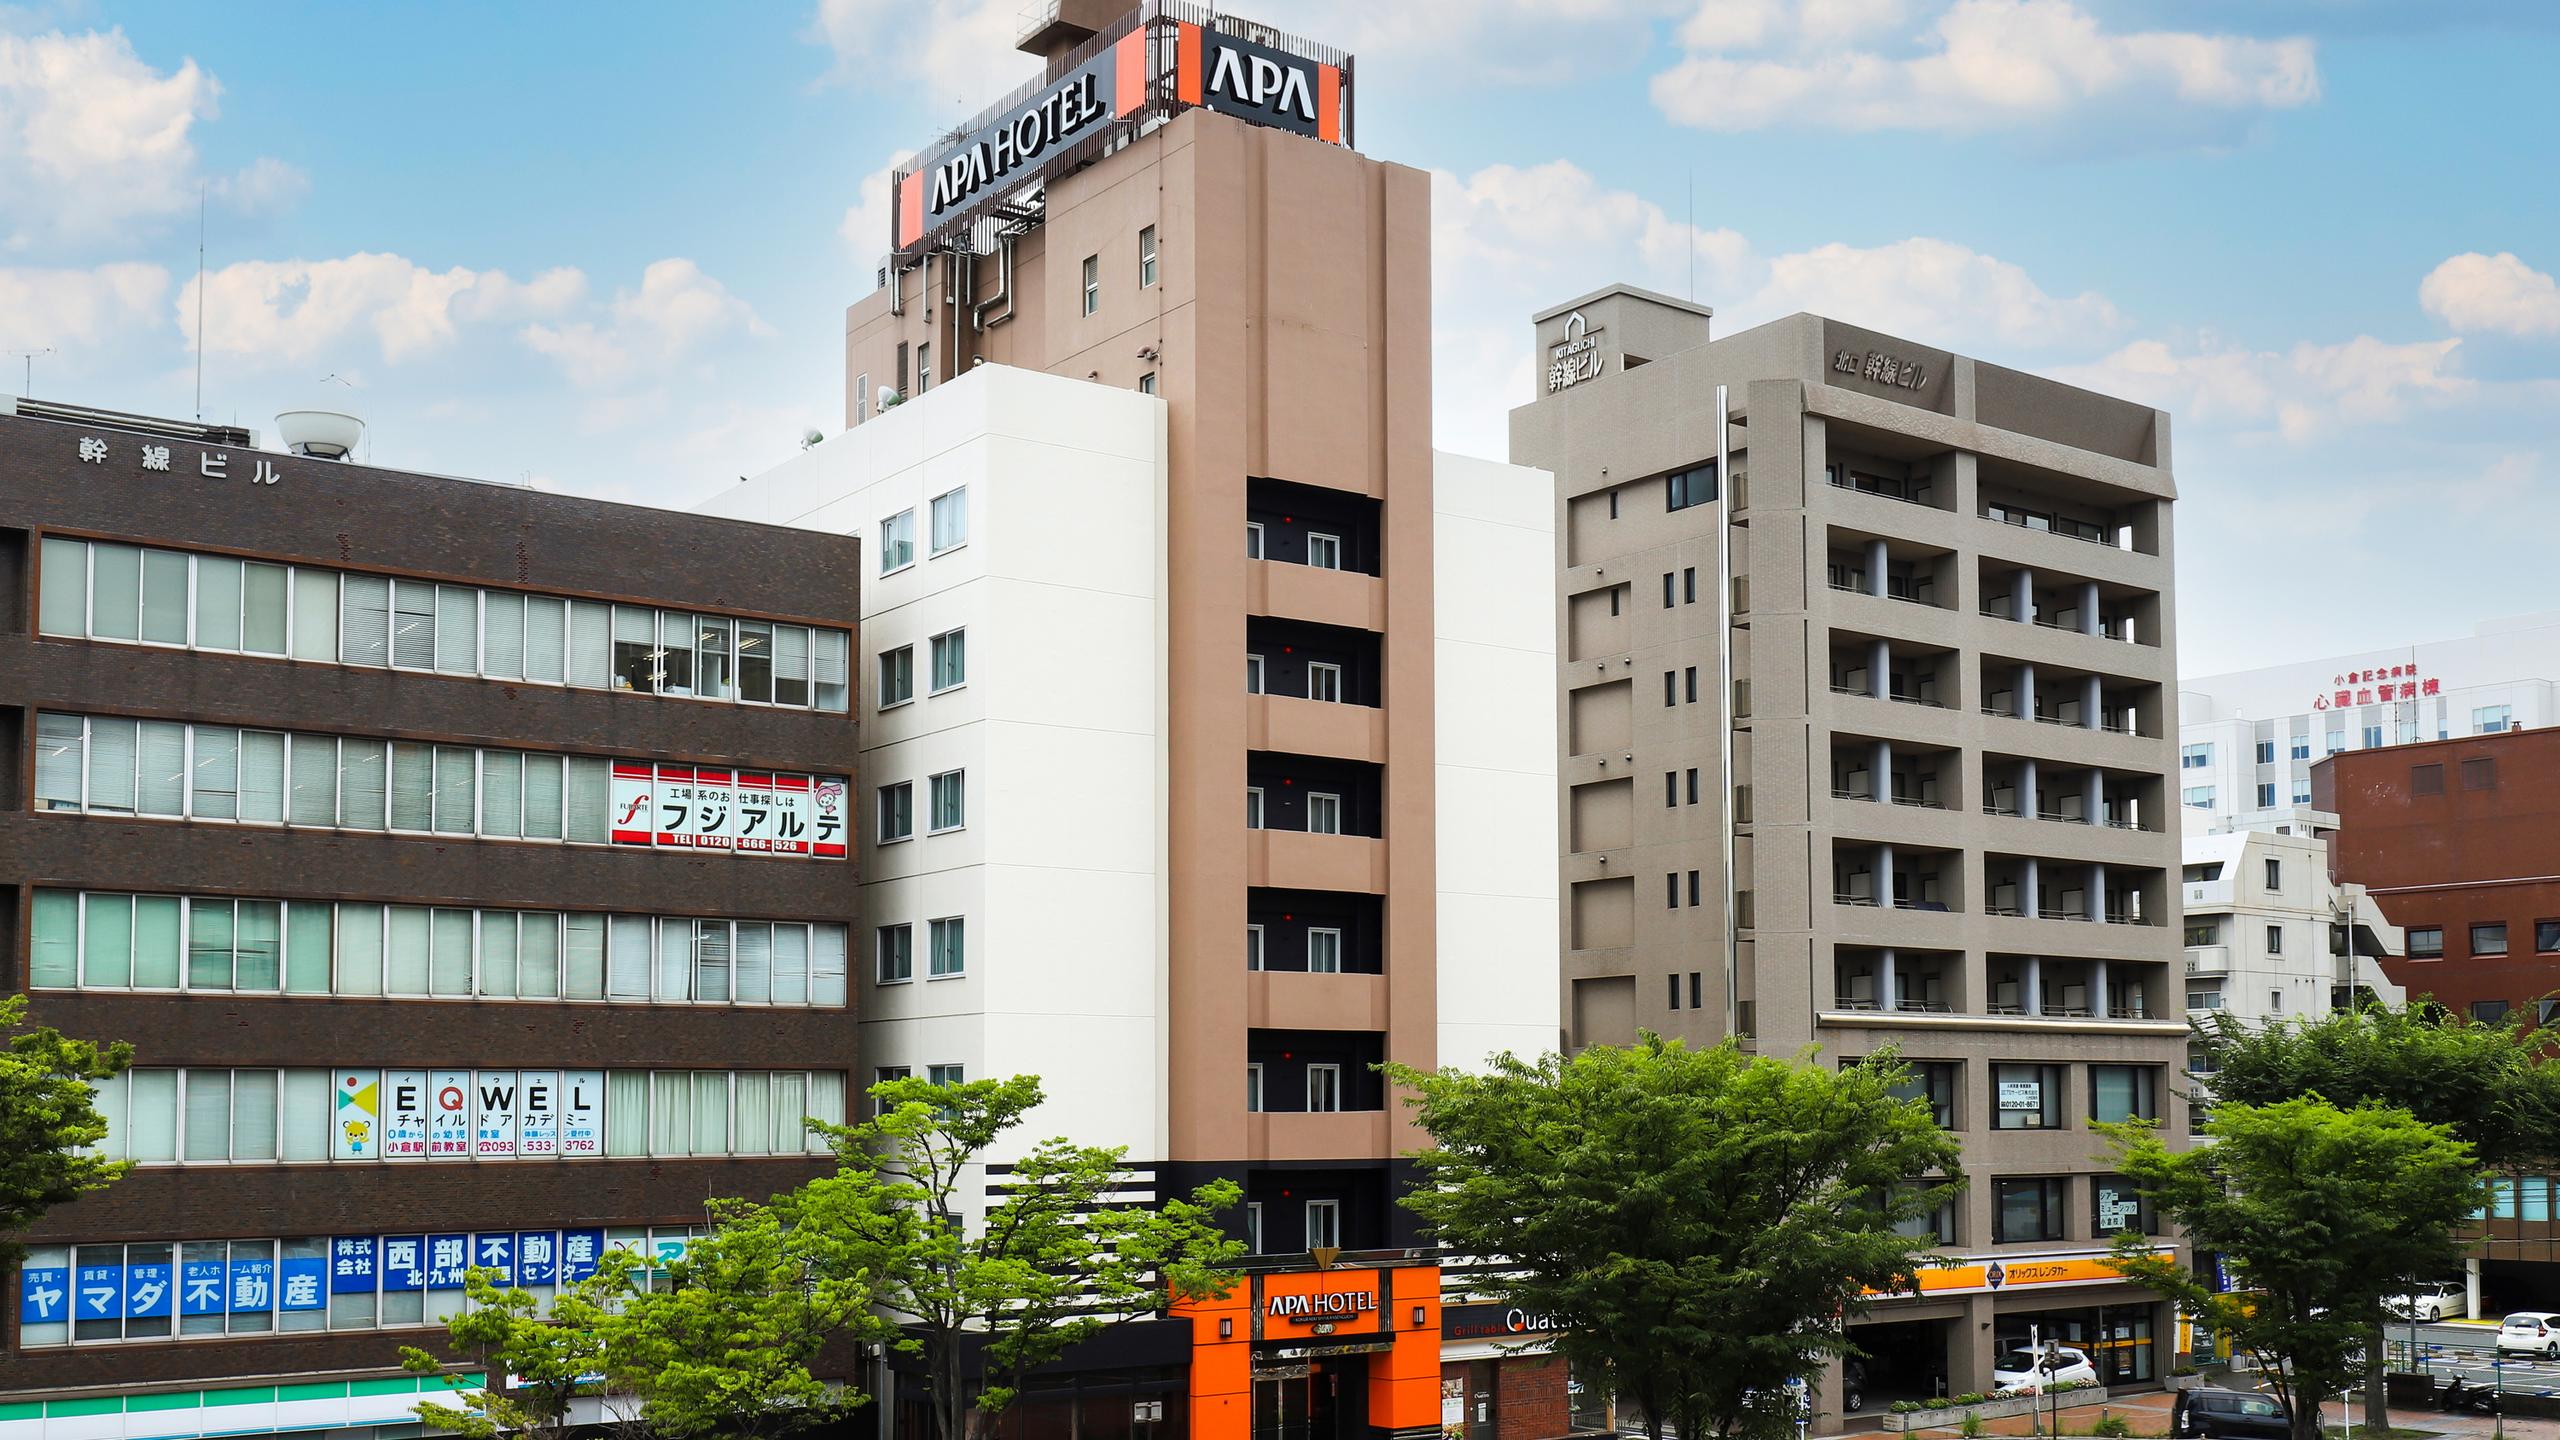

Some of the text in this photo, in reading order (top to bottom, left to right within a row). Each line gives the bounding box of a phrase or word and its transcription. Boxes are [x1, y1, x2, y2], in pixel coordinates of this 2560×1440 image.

[1209, 45, 1317, 122] APA
[930, 73, 1098, 214] APA HOTEL
[1555, 335, 1596, 360] KITAGUCHI
[1549, 350, 1604, 392] 幹線ビル
[1835, 350, 1927, 391] 北口 幹線ビル
[78, 436, 281, 485] 幹線ビル
[669, 788, 795, 808] 工場系のお仕事探しは
[662, 804, 841, 841] フジアルテ
[672, 834, 797, 851] TEL 0120-666-526
[396, 1086, 591, 1111] EQWEL
[388, 1141, 467, 1153] 小倉駅前教室
[338, 1239, 371, 1256] 株式
[388, 1235, 593, 1270] 西部不動産
[337, 1258, 371, 1275] 会社
[407, 1265, 595, 1286] 北九州理センター
[2009, 1266, 2069, 1279] オリックスレンタカー
[28, 1274, 318, 1318] ヤマダ不動産
[1270, 1291, 1377, 1316] APA HOTEL
